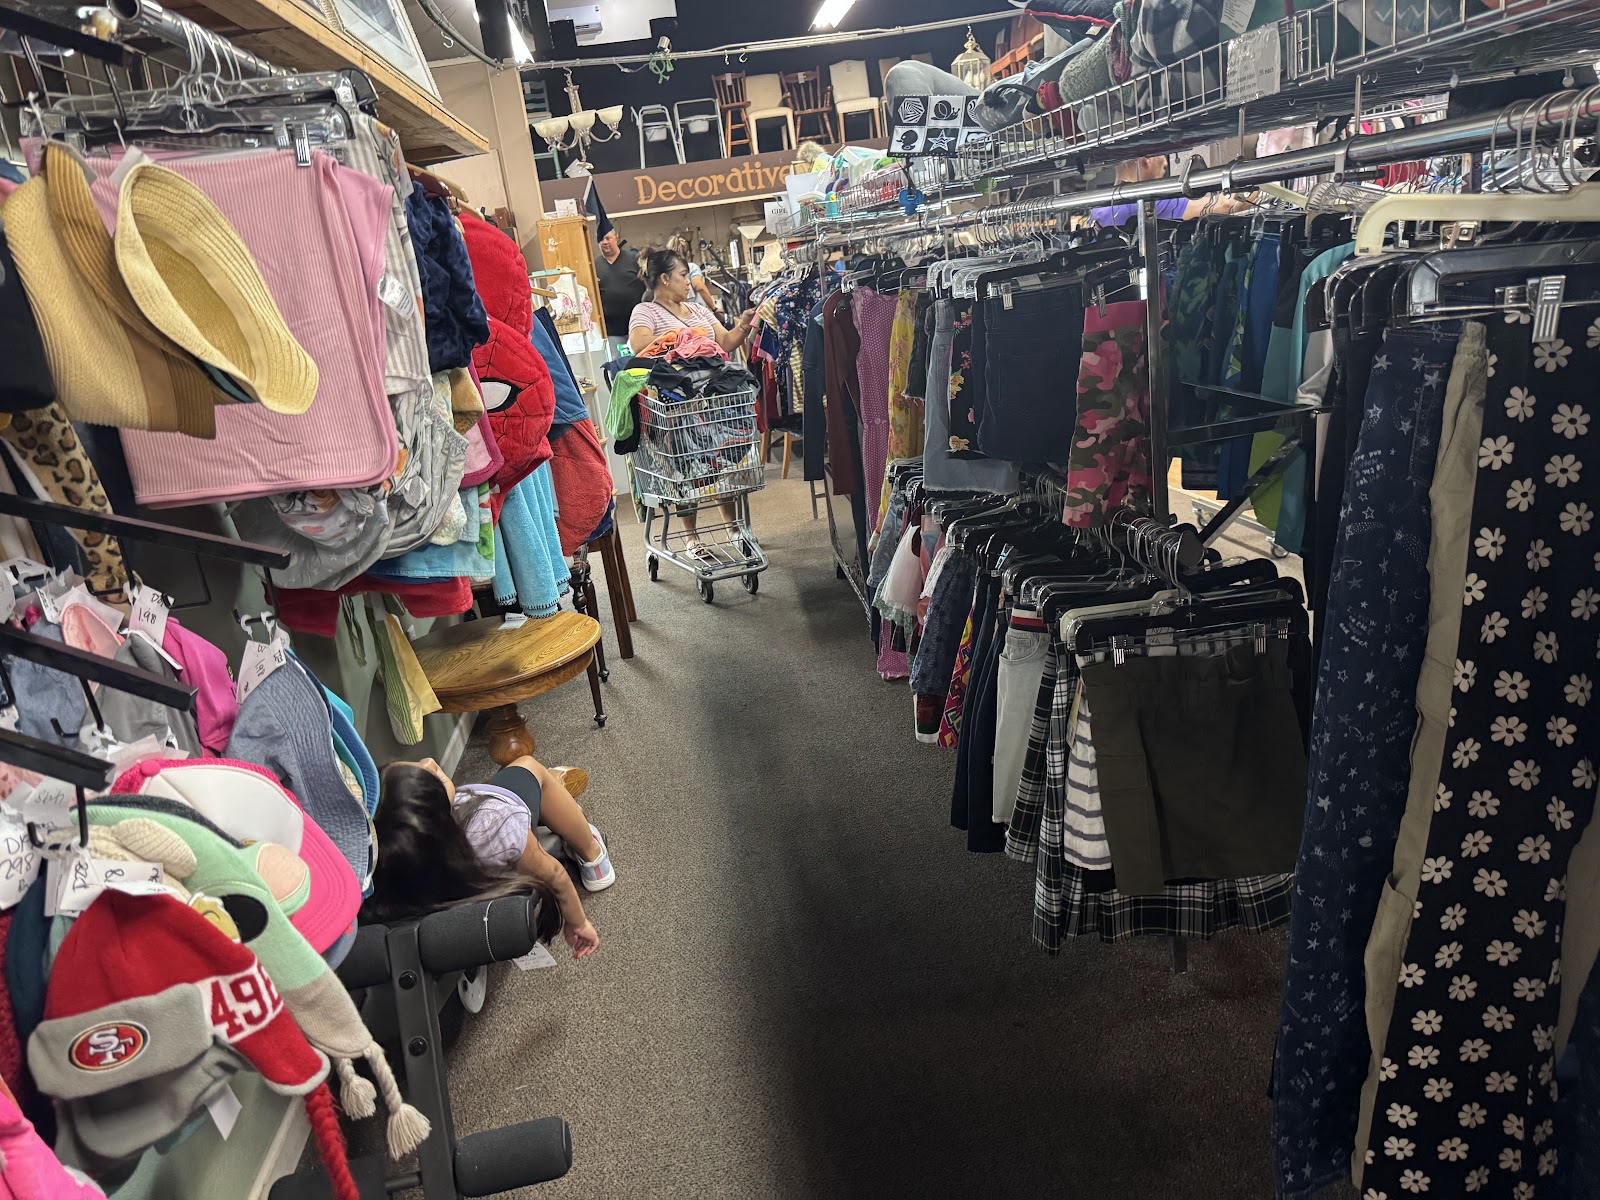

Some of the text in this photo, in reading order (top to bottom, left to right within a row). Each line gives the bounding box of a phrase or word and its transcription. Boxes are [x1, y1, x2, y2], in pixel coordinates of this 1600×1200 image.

[633, 160, 791, 205] Decorative
[138, 607, 157, 625] 1.98
[88, 1027, 134, 1066] SF
